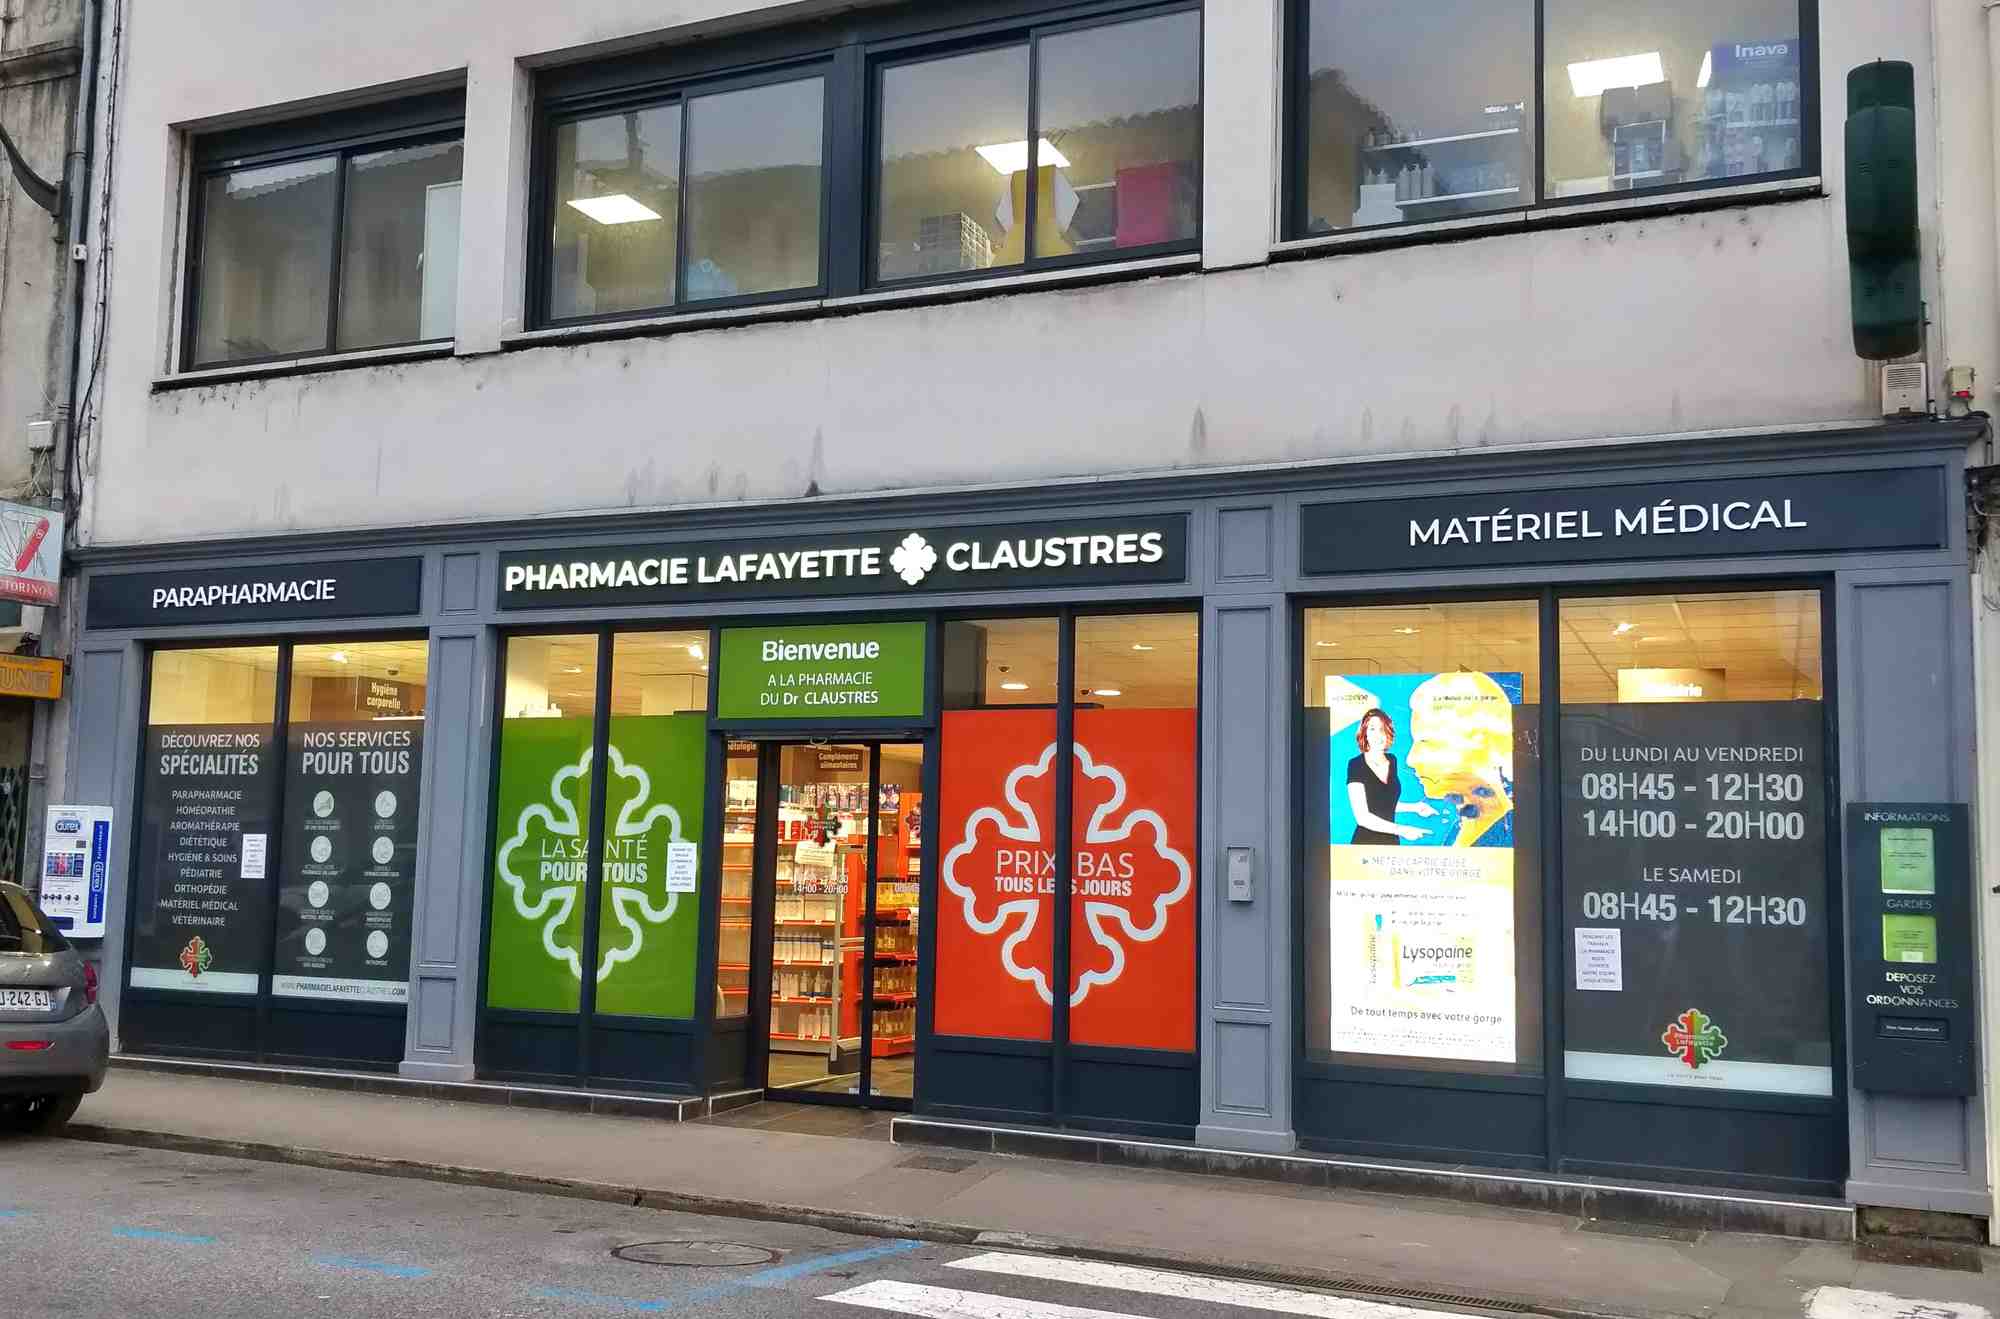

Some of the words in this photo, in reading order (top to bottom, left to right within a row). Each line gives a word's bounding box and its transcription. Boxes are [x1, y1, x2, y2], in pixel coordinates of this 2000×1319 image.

[1735, 43, 1788, 58] Inava
[1409, 509, 1602, 546] MATÉRIEL
[1615, 499, 1807, 536] MÉDICAL
[505, 558, 688, 591] PHARMACIE
[697, 547, 881, 584] LAFAYETTE
[946, 532, 1163, 571] CLAUSTRES
[152, 579, 337, 608] PARAPHARMACIE
[762, 640, 880, 661] Bienvenue
[768, 674, 777, 686] A
[780, 673, 795, 686] LA
[799, 672, 873, 685] PHARMACIE
[760, 693, 778, 705] DU
[783, 692, 799, 705] Dr
[804, 691, 879, 704] CLAUSTRES
[161, 731, 232, 748] DÉCOUVREZ
[235, 734, 260, 748] NOS
[303, 732, 335, 748] NOS
[339, 731, 411, 748] SERVICES
[160, 750, 259, 775] SPÉCIALITÉS
[302, 751, 353, 775] POUR
[359, 751, 410, 775] TOUS
[1581, 748, 1606, 762] DU
[1612, 748, 1668, 762] LUNDI
[1673, 748, 1699, 762] AU
[1704, 748, 1804, 762] VENDREDI
[1581, 772, 1675, 801] 08H45
[1706, 772, 1804, 801] 12H30
[171, 790, 242, 800] PARAPHARMACIE
[176, 805, 236, 815] HOMÉOPATHIE
[1864, 812, 1951, 822] INFORMATIONS
[170, 820, 240, 831] AROMATHÉRAPIE
[1583, 809, 1676, 838] 14H00
[1706, 810, 1805, 840] 20H00
[179, 836, 228, 848] DIÉTÉTIQUE
[541, 839, 565, 858] LA
[168, 852, 203, 862] HYGIÈNE
[212, 854, 238, 862] SOINS
[997, 849, 1056, 874] PRIX
[1077, 852, 1134, 878] BAS
[180, 868, 223, 878] PÉDIATRIE
[540, 861, 588, 882] POUR
[602, 863, 648, 883] TOUS
[1643, 867, 1664, 882] LE
[1668, 868, 1741, 883] SAMEDI
[174, 883, 228, 894] ORTHOPÉDIE
[994, 877, 1033, 893] TOUS
[1037, 878, 1077, 894] LES
[1080, 880, 1132, 896] JOURS
[160, 898, 200, 909] MATÉRIEL
[201, 899, 239, 911] MÉDICAL
[1583, 892, 1677, 921] 08H45
[1708, 895, 1806, 925] 12H30
[1886, 899, 1933, 909] GARDES
[171, 914, 225, 926] VÉTÉRINAIRE
[1402, 945, 1473, 963] Lysopaine
[1899, 984, 1924, 995] VOS
[1866, 994, 1960, 1008] ORDONNANCES
[1350, 1006, 1363, 1015] De
[1365, 1007, 1385, 1017] tout
[1388, 1009, 1418, 1019] temps
[1420, 1012, 1441, 1020] avec
[1444, 1013, 1470, 1022] votre
[1473, 1015, 1502, 1025] gorge
